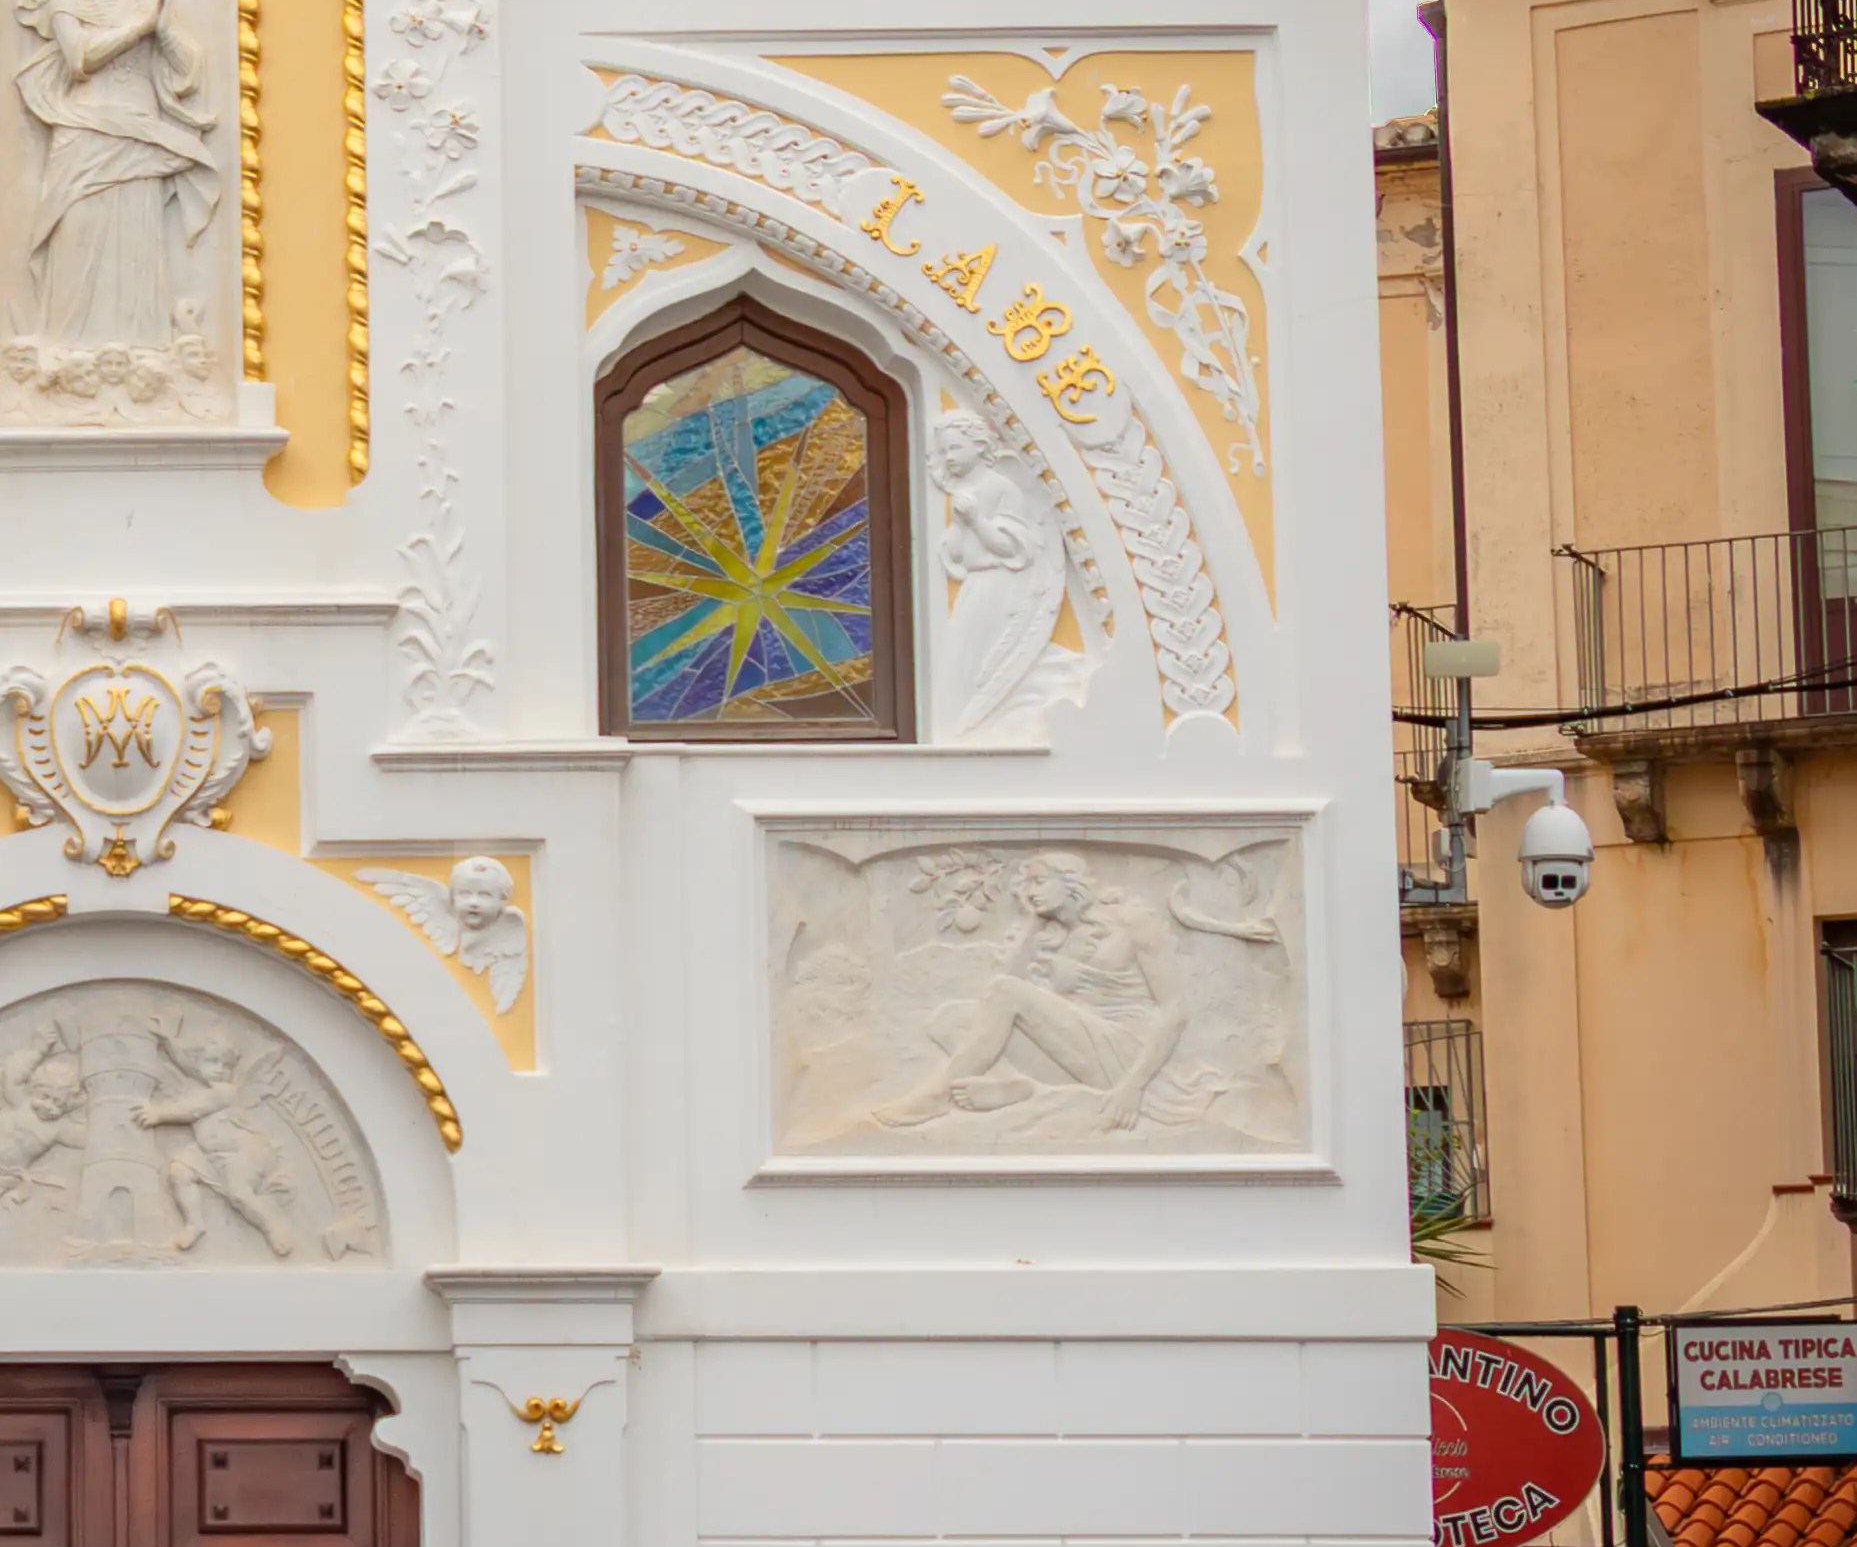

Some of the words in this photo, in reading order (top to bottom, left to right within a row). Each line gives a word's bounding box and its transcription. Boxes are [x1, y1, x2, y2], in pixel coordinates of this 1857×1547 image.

[1683, 1339, 1772, 1362] CUCINA
[1778, 1337, 1857, 1360] TIPICA
[1700, 1367, 1843, 1391] CALABRESE
[1692, 1416, 1756, 1429] AMBIENTE
[1760, 1413, 1854, 1428] CLIMATIZZATO
[1709, 1435, 1729, 1446] AIR
[1747, 1432, 1838, 1446] CONDITIONED
